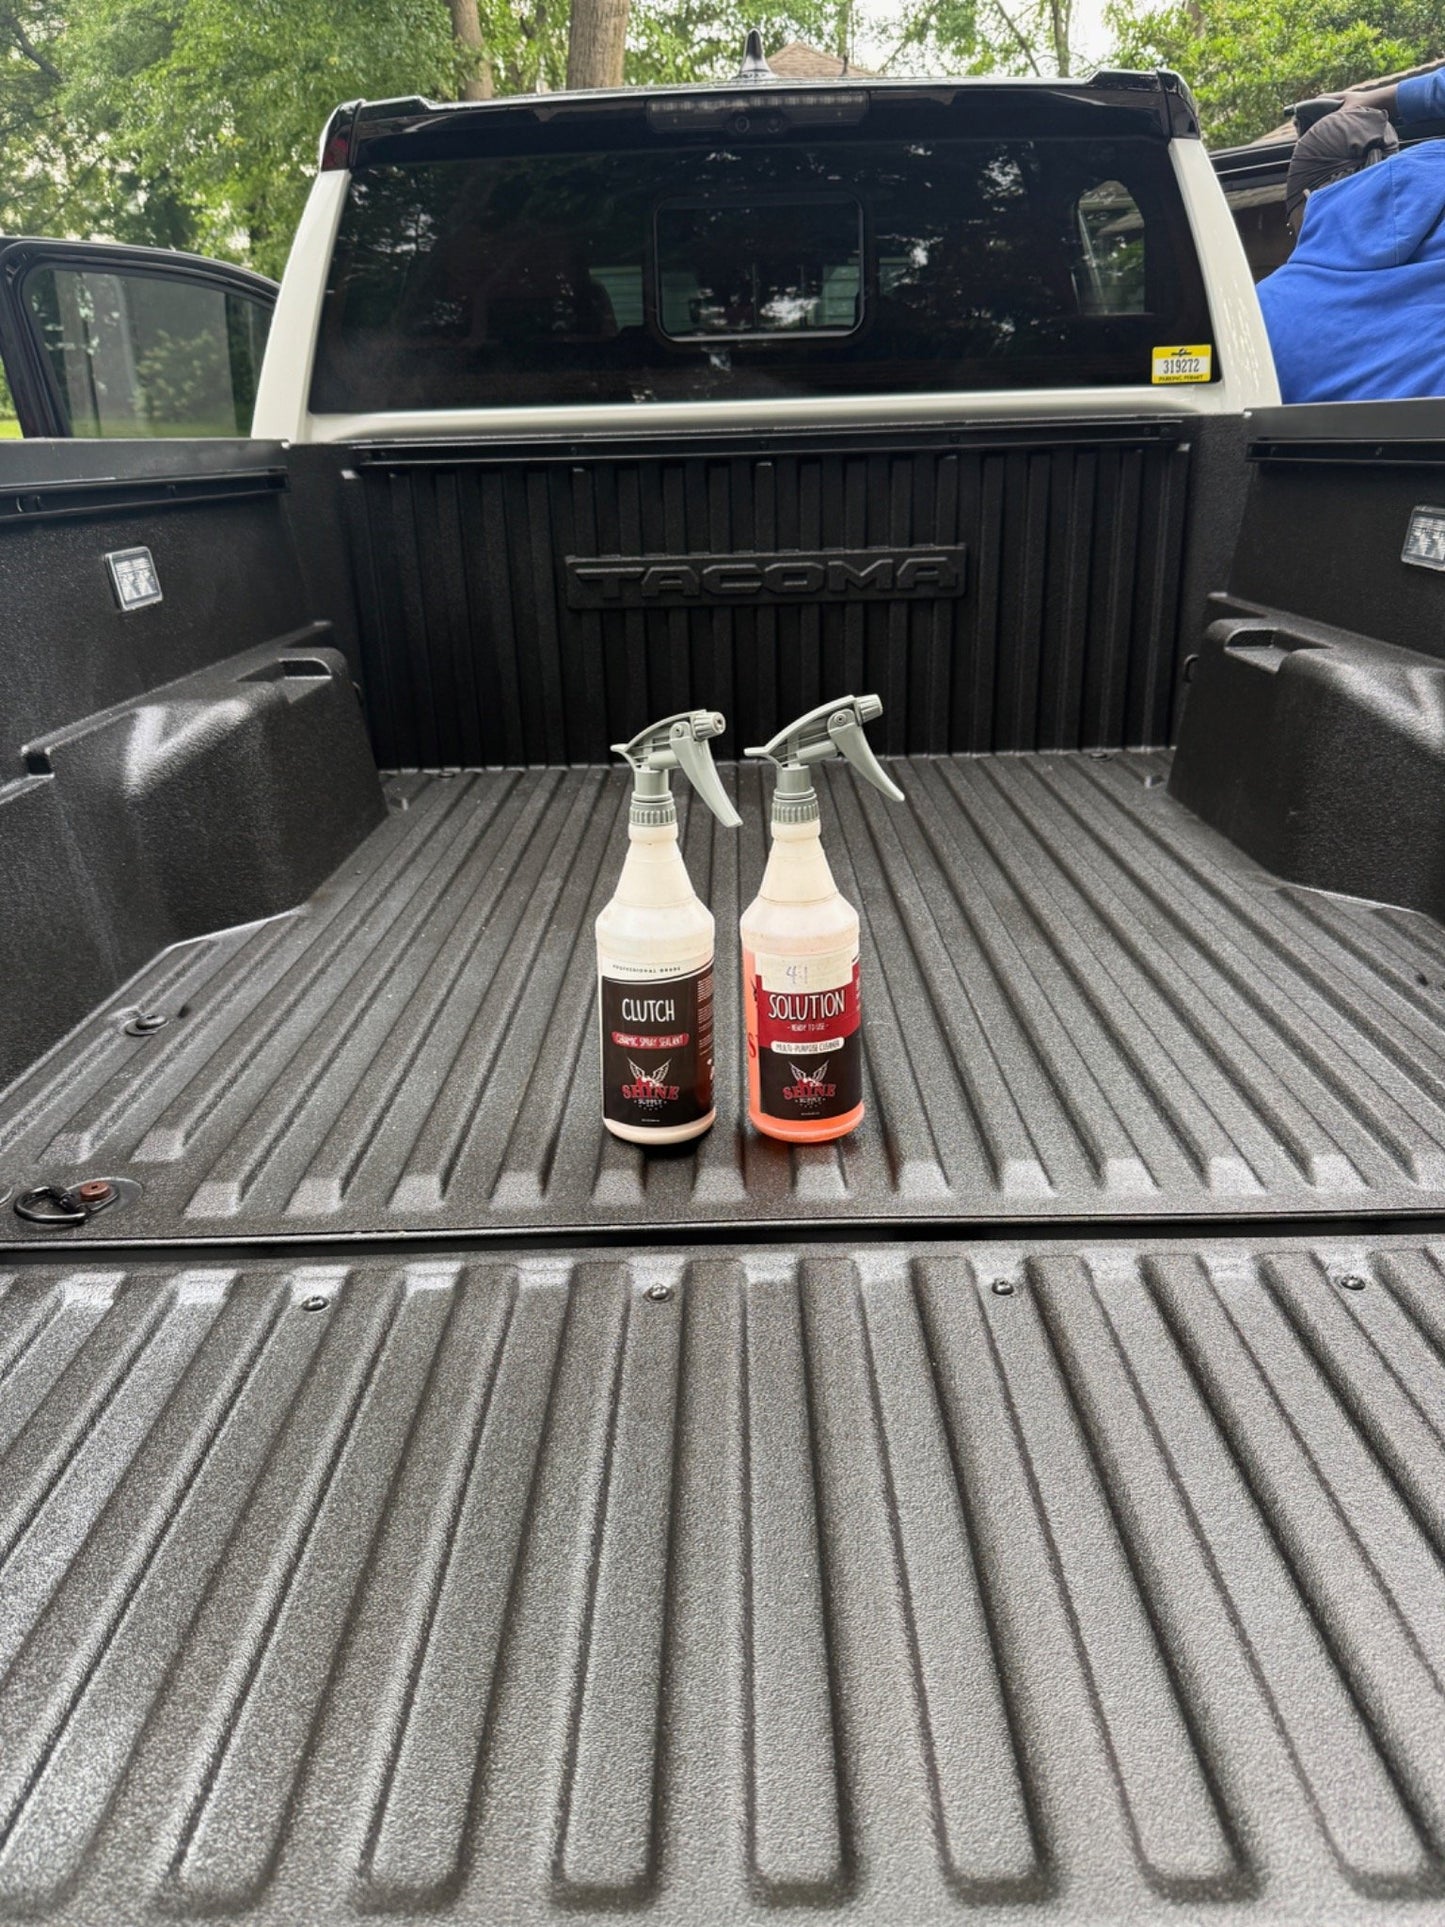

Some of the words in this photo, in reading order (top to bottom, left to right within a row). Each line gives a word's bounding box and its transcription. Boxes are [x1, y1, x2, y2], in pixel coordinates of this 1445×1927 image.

[1163, 358, 1200, 374] 319272
[574, 556, 957, 597] TACOMA
[622, 998, 676, 1022] CLUTCH
[768, 990, 845, 1021] SOLUTION
[621, 1083, 680, 1100] SHINE
[782, 1083, 837, 1100] SHINE
